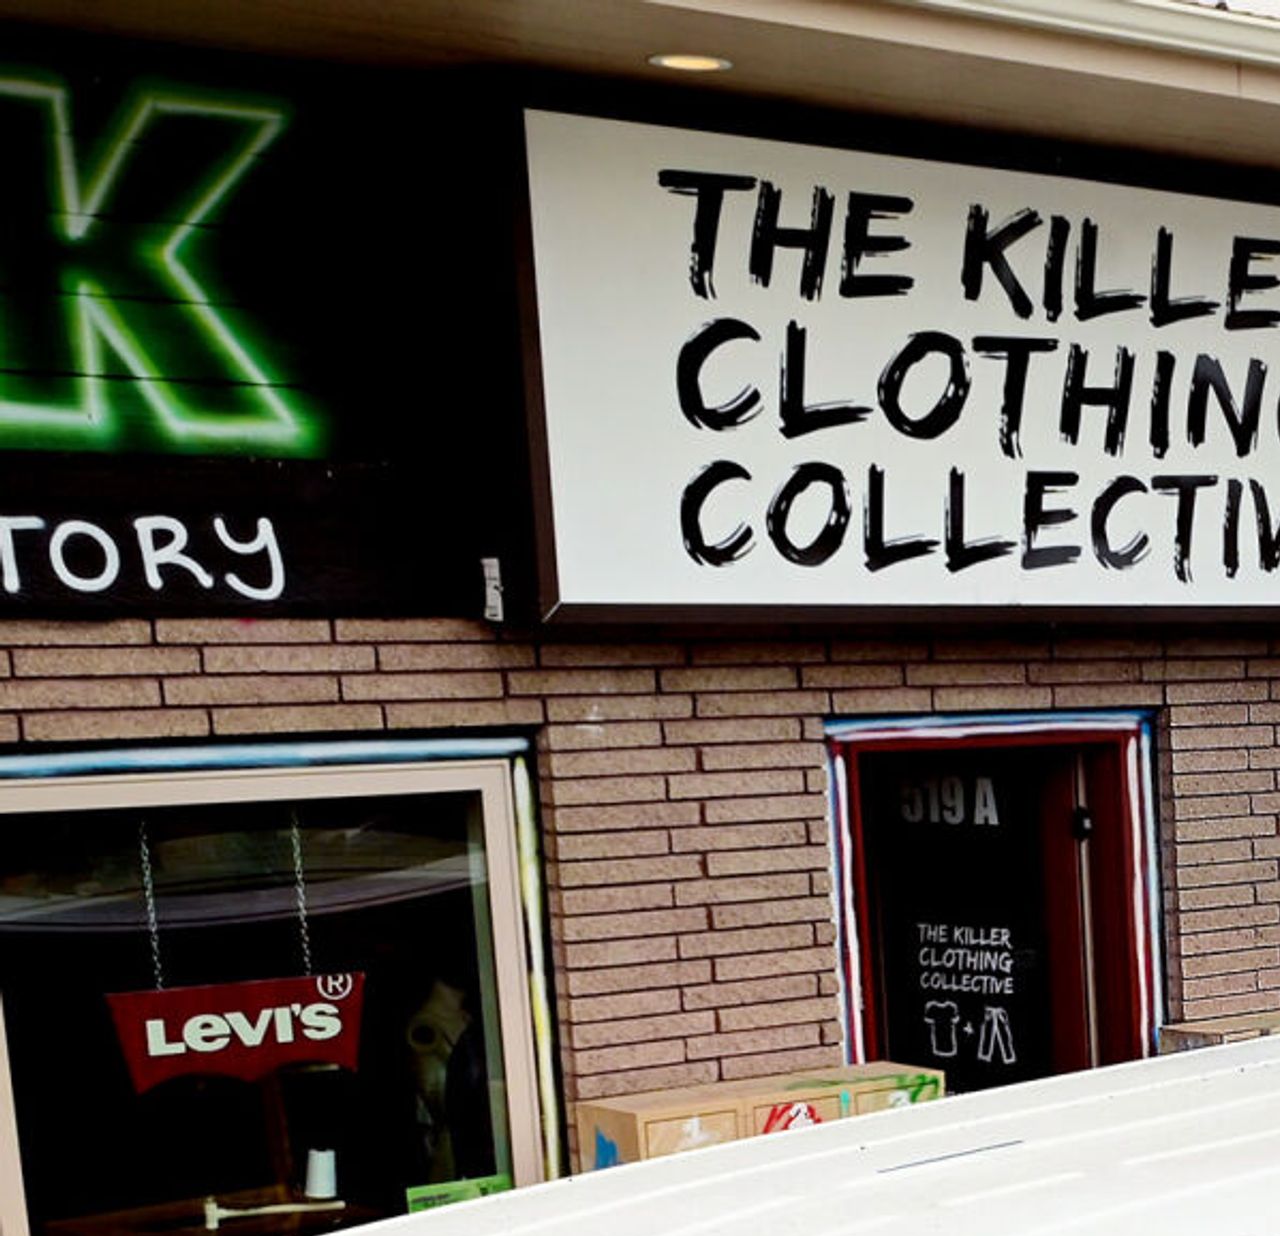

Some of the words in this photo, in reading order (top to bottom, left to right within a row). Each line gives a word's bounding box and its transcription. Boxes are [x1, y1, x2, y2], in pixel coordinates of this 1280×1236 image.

[658, 168, 914, 301] THE
[972, 776, 1000, 827] A
[917, 922, 950, 944] THE
[952, 924, 1013, 950] KILLER
[918, 946, 1013, 974] CLOTHING
[919, 971, 1014, 996] COLLECTIVE
